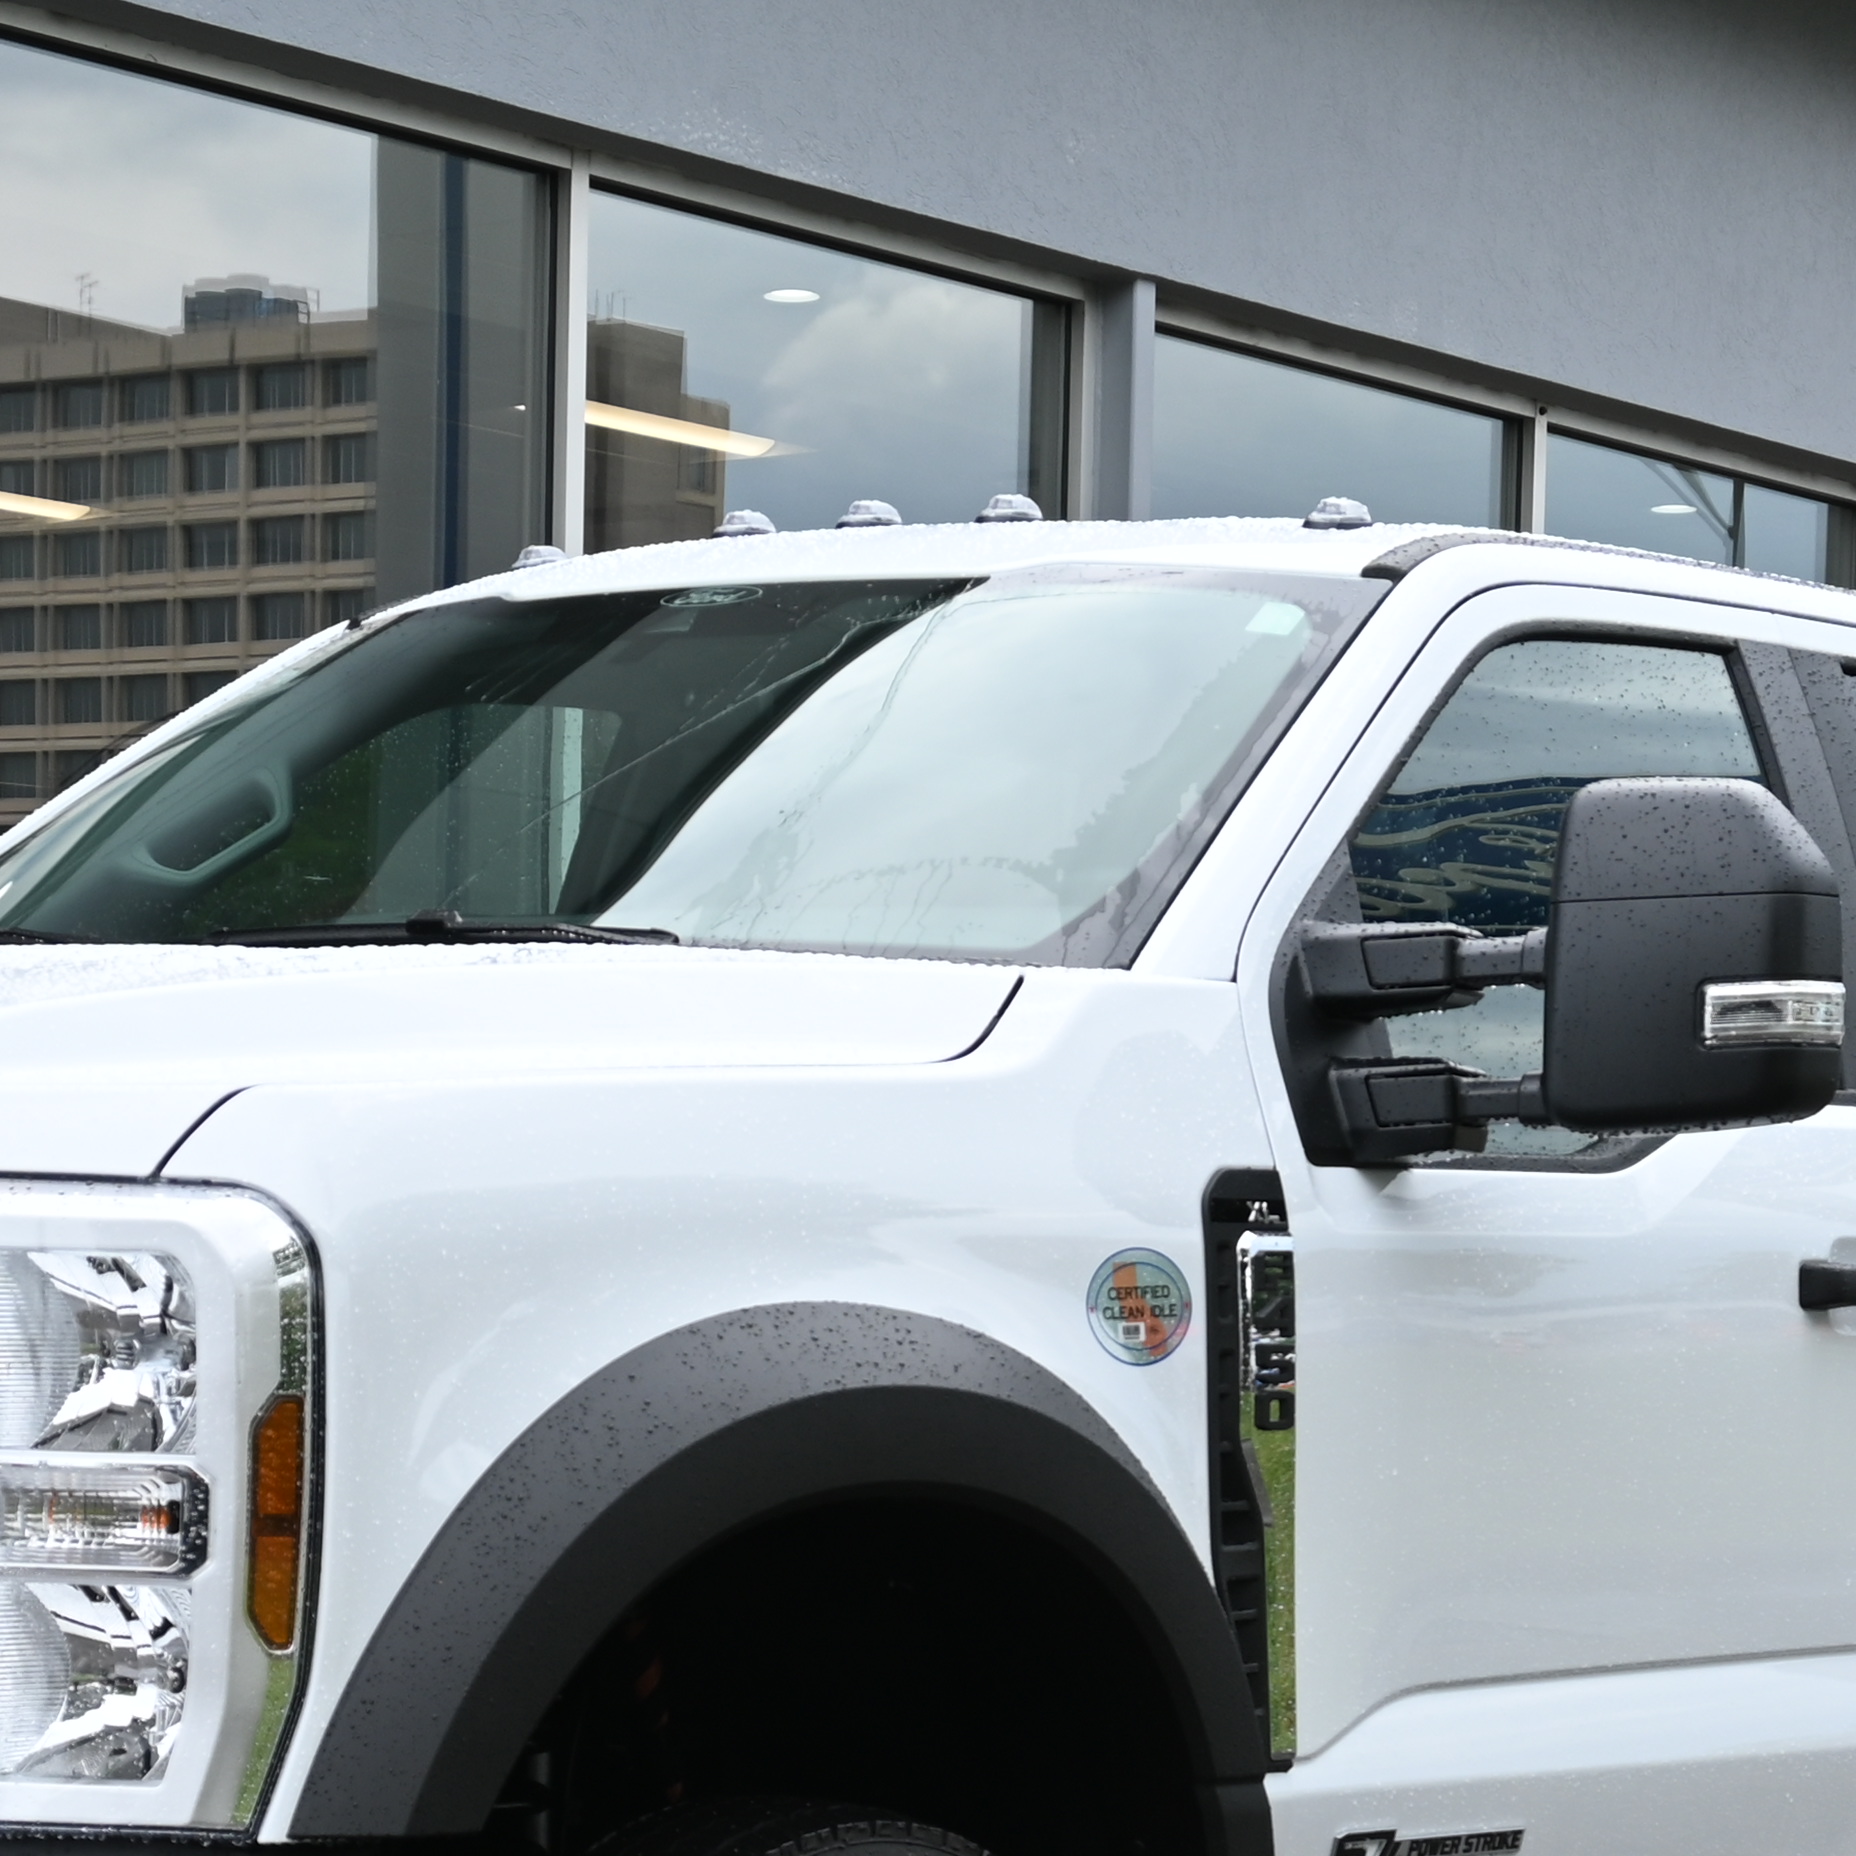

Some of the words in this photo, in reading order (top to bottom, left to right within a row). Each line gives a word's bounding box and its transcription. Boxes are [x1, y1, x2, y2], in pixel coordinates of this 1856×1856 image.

[673, 587, 747, 605] Ford
[1246, 1201, 1280, 1222] XL
[1107, 1284, 1171, 1301] CERTIFIED
[1102, 1305, 1145, 1320] CLEAN
[1151, 1303, 1178, 1318] IDLE
[1462, 1830, 1524, 1853] STROKE
